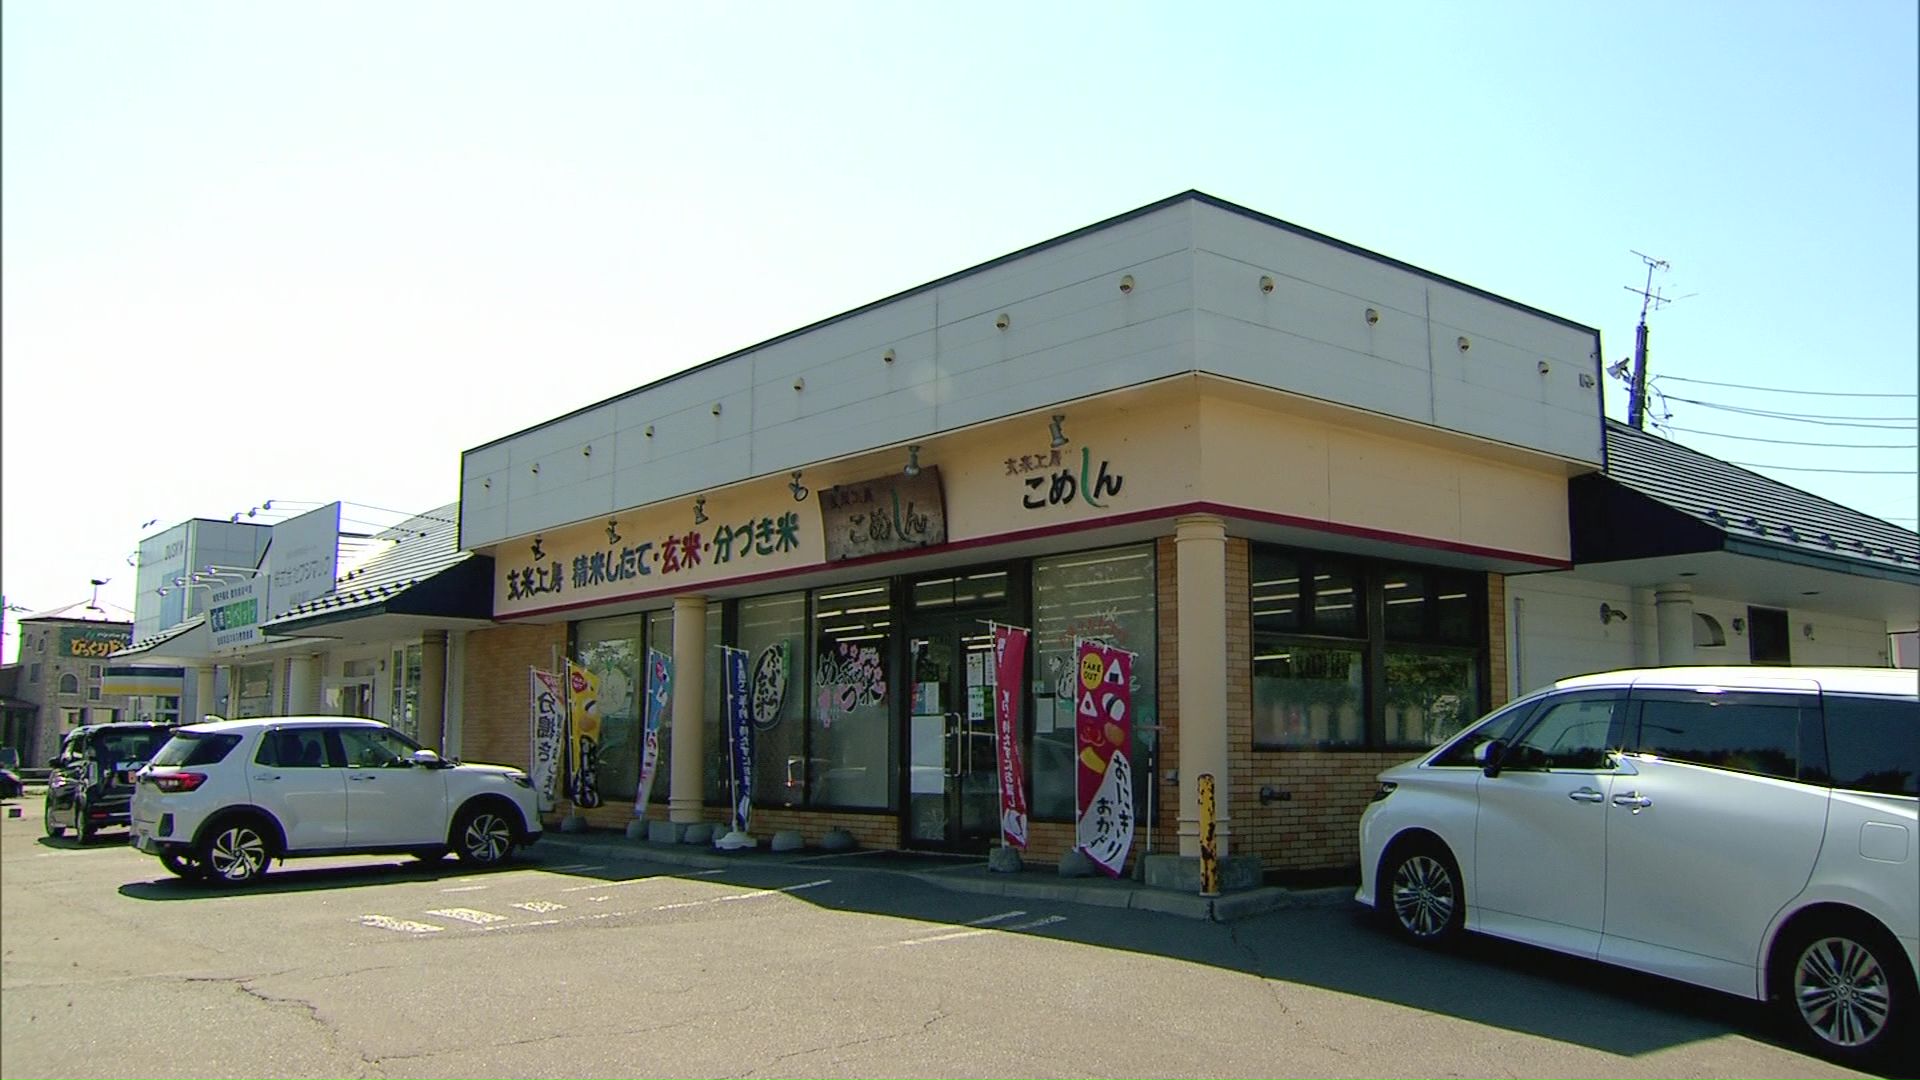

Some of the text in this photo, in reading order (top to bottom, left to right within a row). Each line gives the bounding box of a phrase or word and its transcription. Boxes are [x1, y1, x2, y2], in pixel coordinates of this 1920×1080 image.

[1023, 445, 1123, 511] こめしん
[507, 560, 563, 602] 玄米工房
[1083, 660, 1102, 672] TAKE
[1084, 671, 1099, 682] OUT
[1104, 754, 1132, 863] おにぎり
